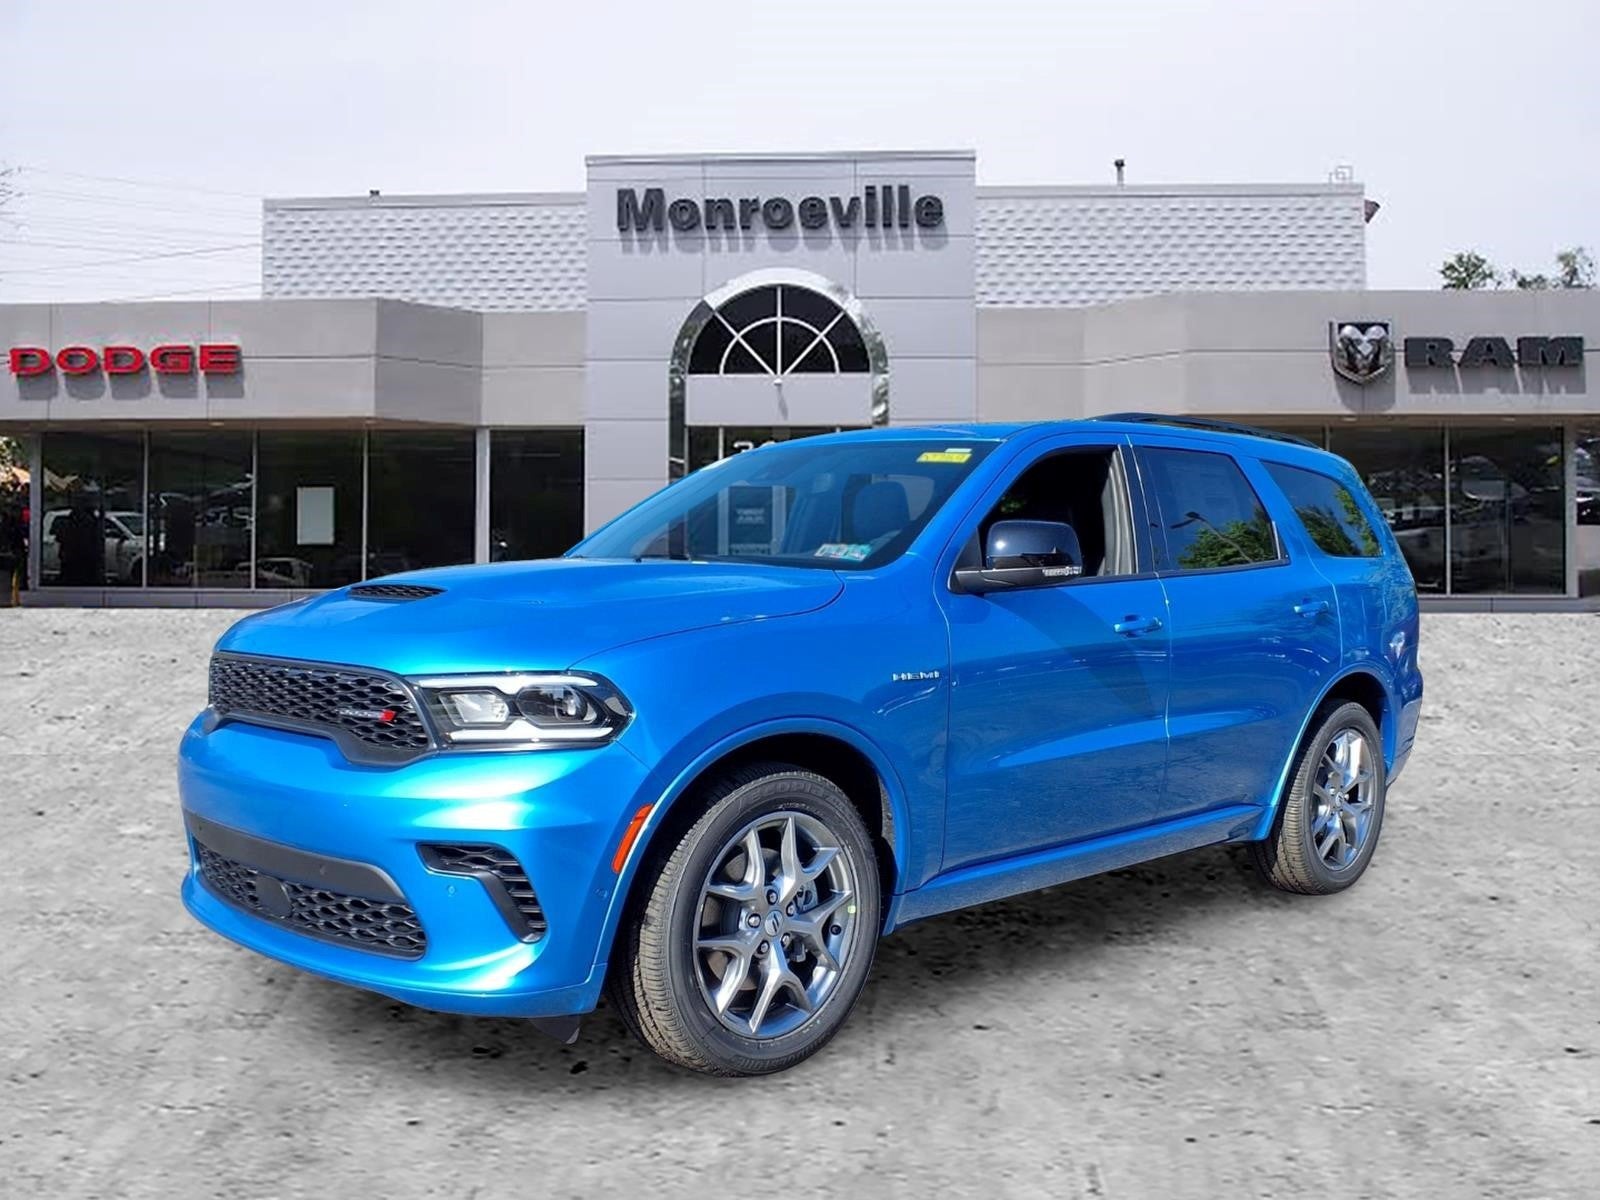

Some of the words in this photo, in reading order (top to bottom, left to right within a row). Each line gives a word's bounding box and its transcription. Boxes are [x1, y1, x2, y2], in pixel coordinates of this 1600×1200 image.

[617, 185, 944, 231] Monroeville
[9, 343, 241, 374] DODGE
[1404, 336, 1584, 367] RAM
[892, 670, 940, 681] HEMI
